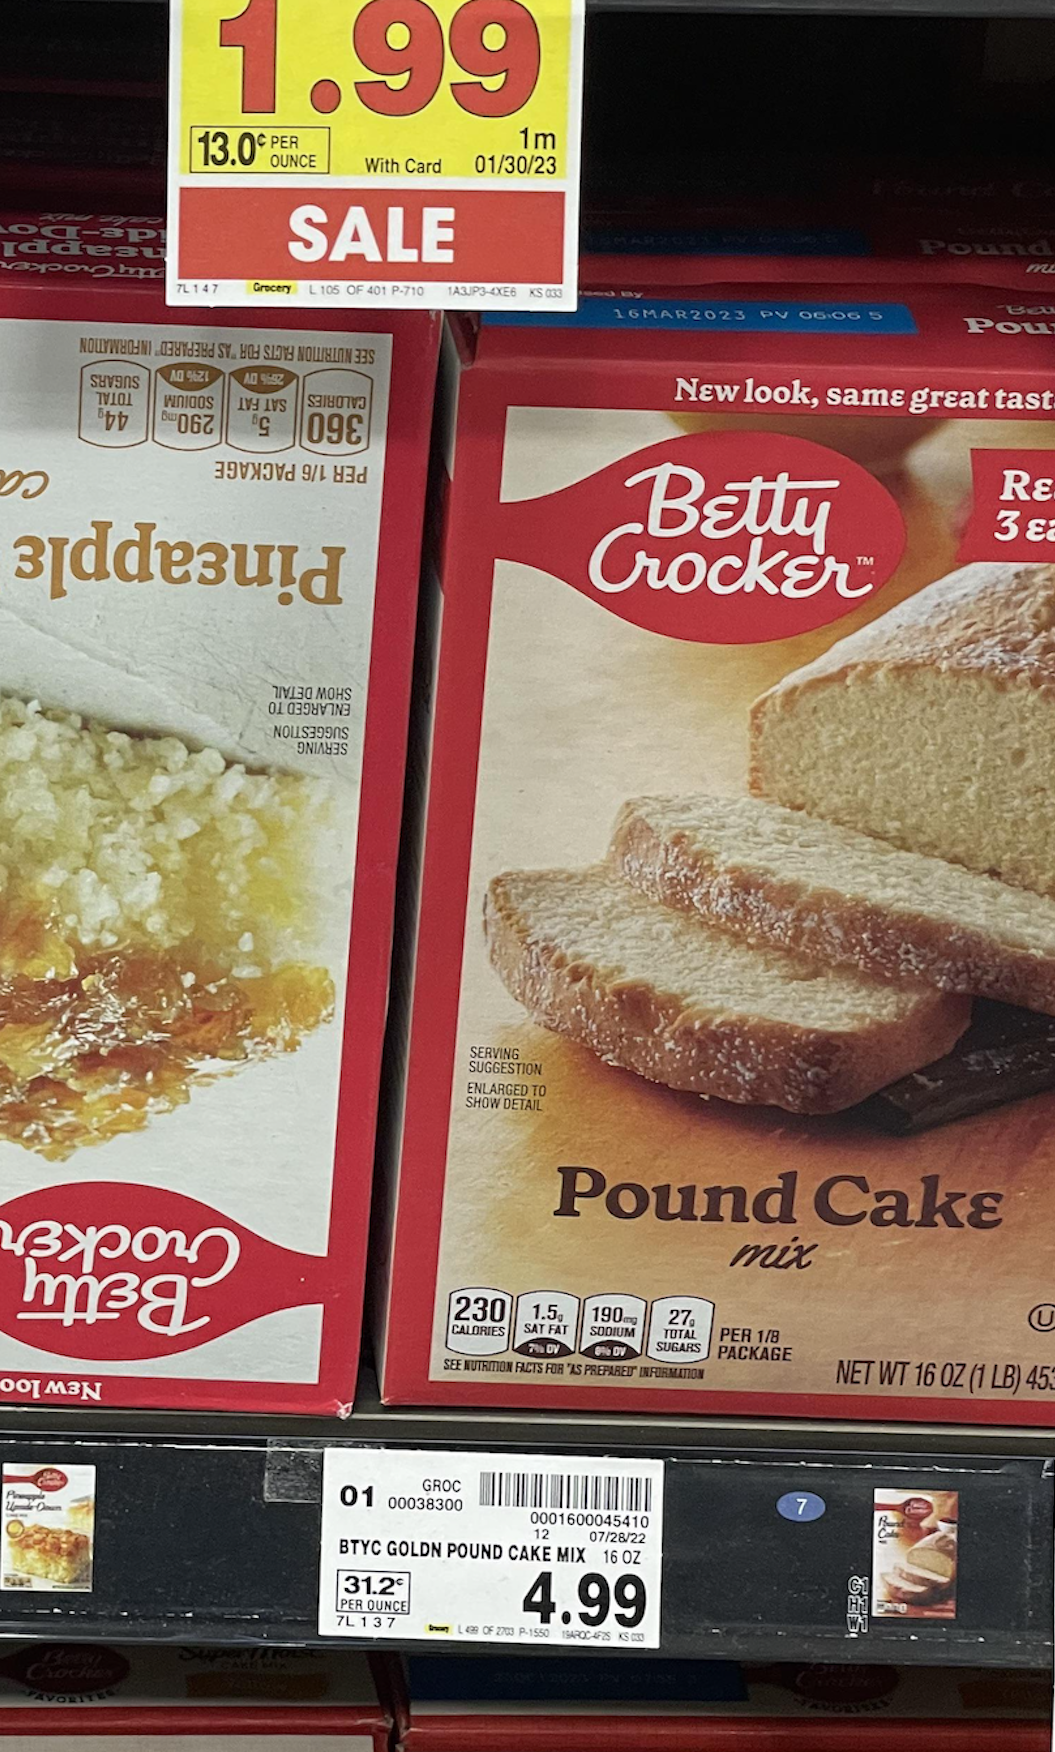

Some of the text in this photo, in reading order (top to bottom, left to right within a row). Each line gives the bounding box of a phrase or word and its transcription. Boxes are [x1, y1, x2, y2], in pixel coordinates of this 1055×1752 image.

[220, 0, 541, 117] 1.99
[270, 135, 299, 150] PER
[519, 128, 556, 150] 1m
[270, 154, 317, 169] OUNCE
[365, 157, 442, 174] With Card
[475, 155, 557, 175] 01/30/23
[287, 204, 456, 263] SALE
[252, 283, 292, 295] Grocery
[613, 308, 745, 321] 16MAR2023
[760, 309, 788, 321] PV
[90, 374, 139, 389] SUGARS
[96, 391, 133, 406] TOTAL
[163, 394, 214, 409] SODIUM
[308, 394, 366, 410] CALORIES
[674, 378, 988, 414] New look, same great
[237, 397, 287, 412] SAT FAT
[162, 410, 214, 435] 290mg
[307, 412, 362, 445] 360
[215, 462, 367, 483] PER 1/6 PACKAGE
[624, 462, 840, 555] Betty
[13, 520, 346, 606] Pineapple
[588, 523, 875, 598] Crocker
[273, 685, 352, 701] SHOW DETAIL
[269, 701, 350, 716] ENLARGED TO
[273, 725, 349, 740] SUGGESTION
[297, 741, 348, 755] SERVING
[470, 1046, 519, 1060] SERVING
[469, 1061, 542, 1076] SUGGESTION
[467, 1082, 547, 1097] ENLARGED TO
[465, 1097, 543, 1111] SHOW DETAIL
[553, 1166, 1003, 1229] Pound Cake
[729, 1237, 819, 1271] mix
[17, 1257, 210, 1336] Betty
[454, 1296, 506, 1323] 230
[451, 1324, 506, 1337] CALORIES
[524, 1323, 569, 1336] SAT FAT
[590, 1326, 635, 1338] SODIUM
[663, 1328, 697, 1340] TOTAL
[720, 1327, 780, 1343] PER 1/8
[655, 1341, 702, 1354] SUGARS
[718, 1346, 792, 1362] PACKAGE
[836, 1359, 1022, 1395] NET WT 16 OZ (1 LB)
[44, 1381, 102, 1400] New
[422, 1479, 462, 1493] GROC
[340, 1485, 374, 1507] 01
[388, 1497, 463, 1511] 00038300
[796, 1499, 808, 1515] 7
[530, 1512, 650, 1529] 0001600045410
[535, 1528, 550, 1540] 12
[589, 1531, 646, 1544] 07/28/22
[339, 1539, 642, 1565] BTYC GOLDN POUND CAKE MIX 16 OZ
[340, 1598, 407, 1612] PER OUNCE
[523, 1571, 647, 1628] 4.99
